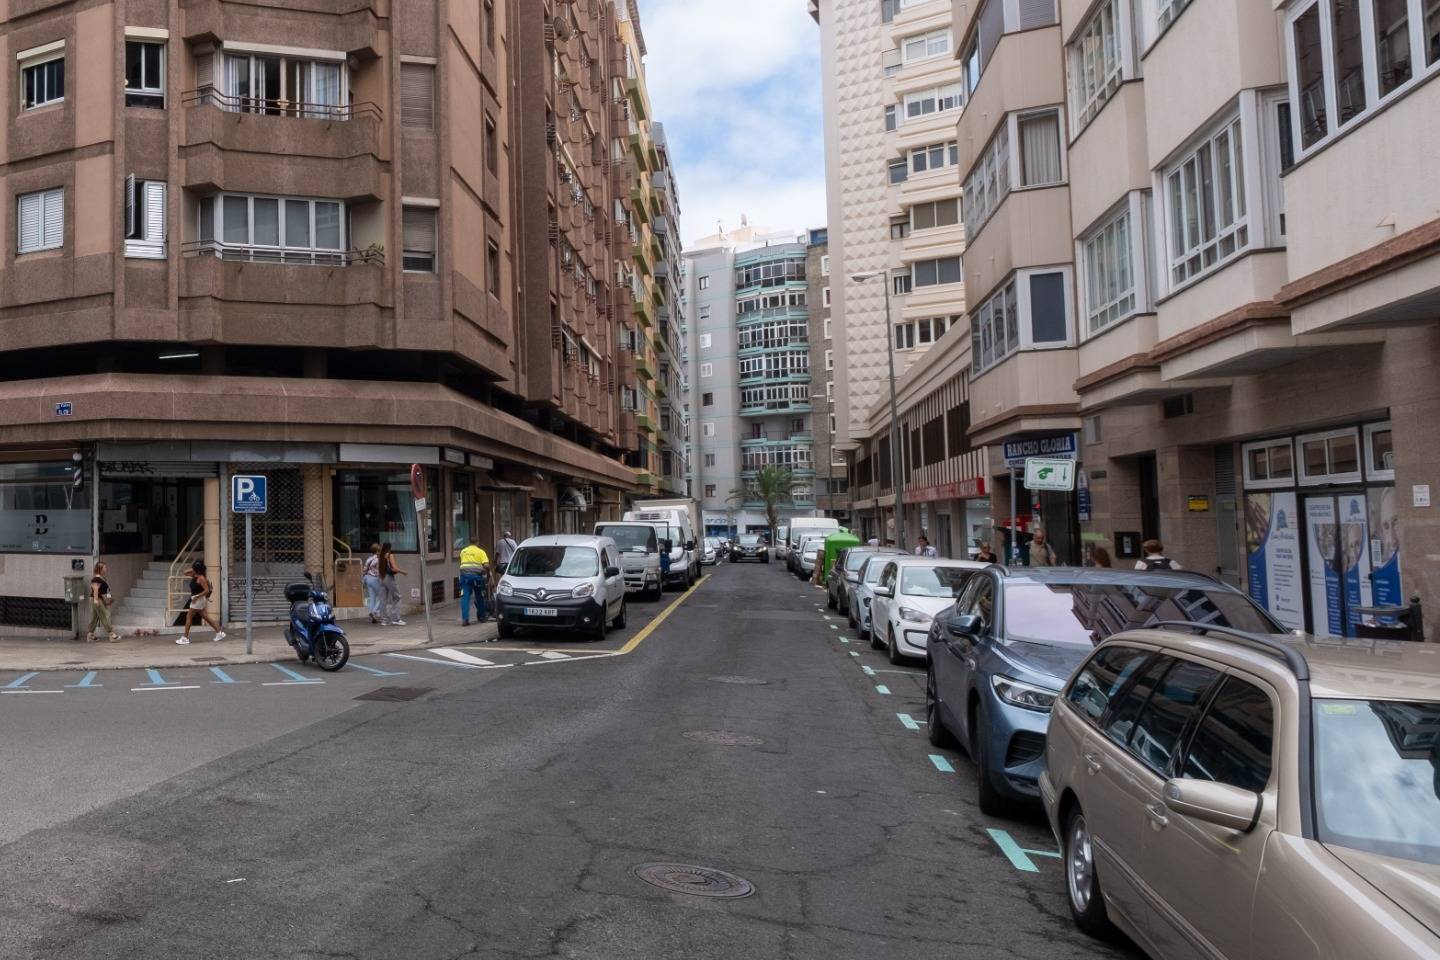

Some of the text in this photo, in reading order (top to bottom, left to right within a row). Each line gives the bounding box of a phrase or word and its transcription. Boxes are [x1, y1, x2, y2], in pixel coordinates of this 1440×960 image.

[1006, 441, 1039, 457] RANCHO
[1040, 436, 1072, 453] GLORIA
[237, 478, 255, 501] P
